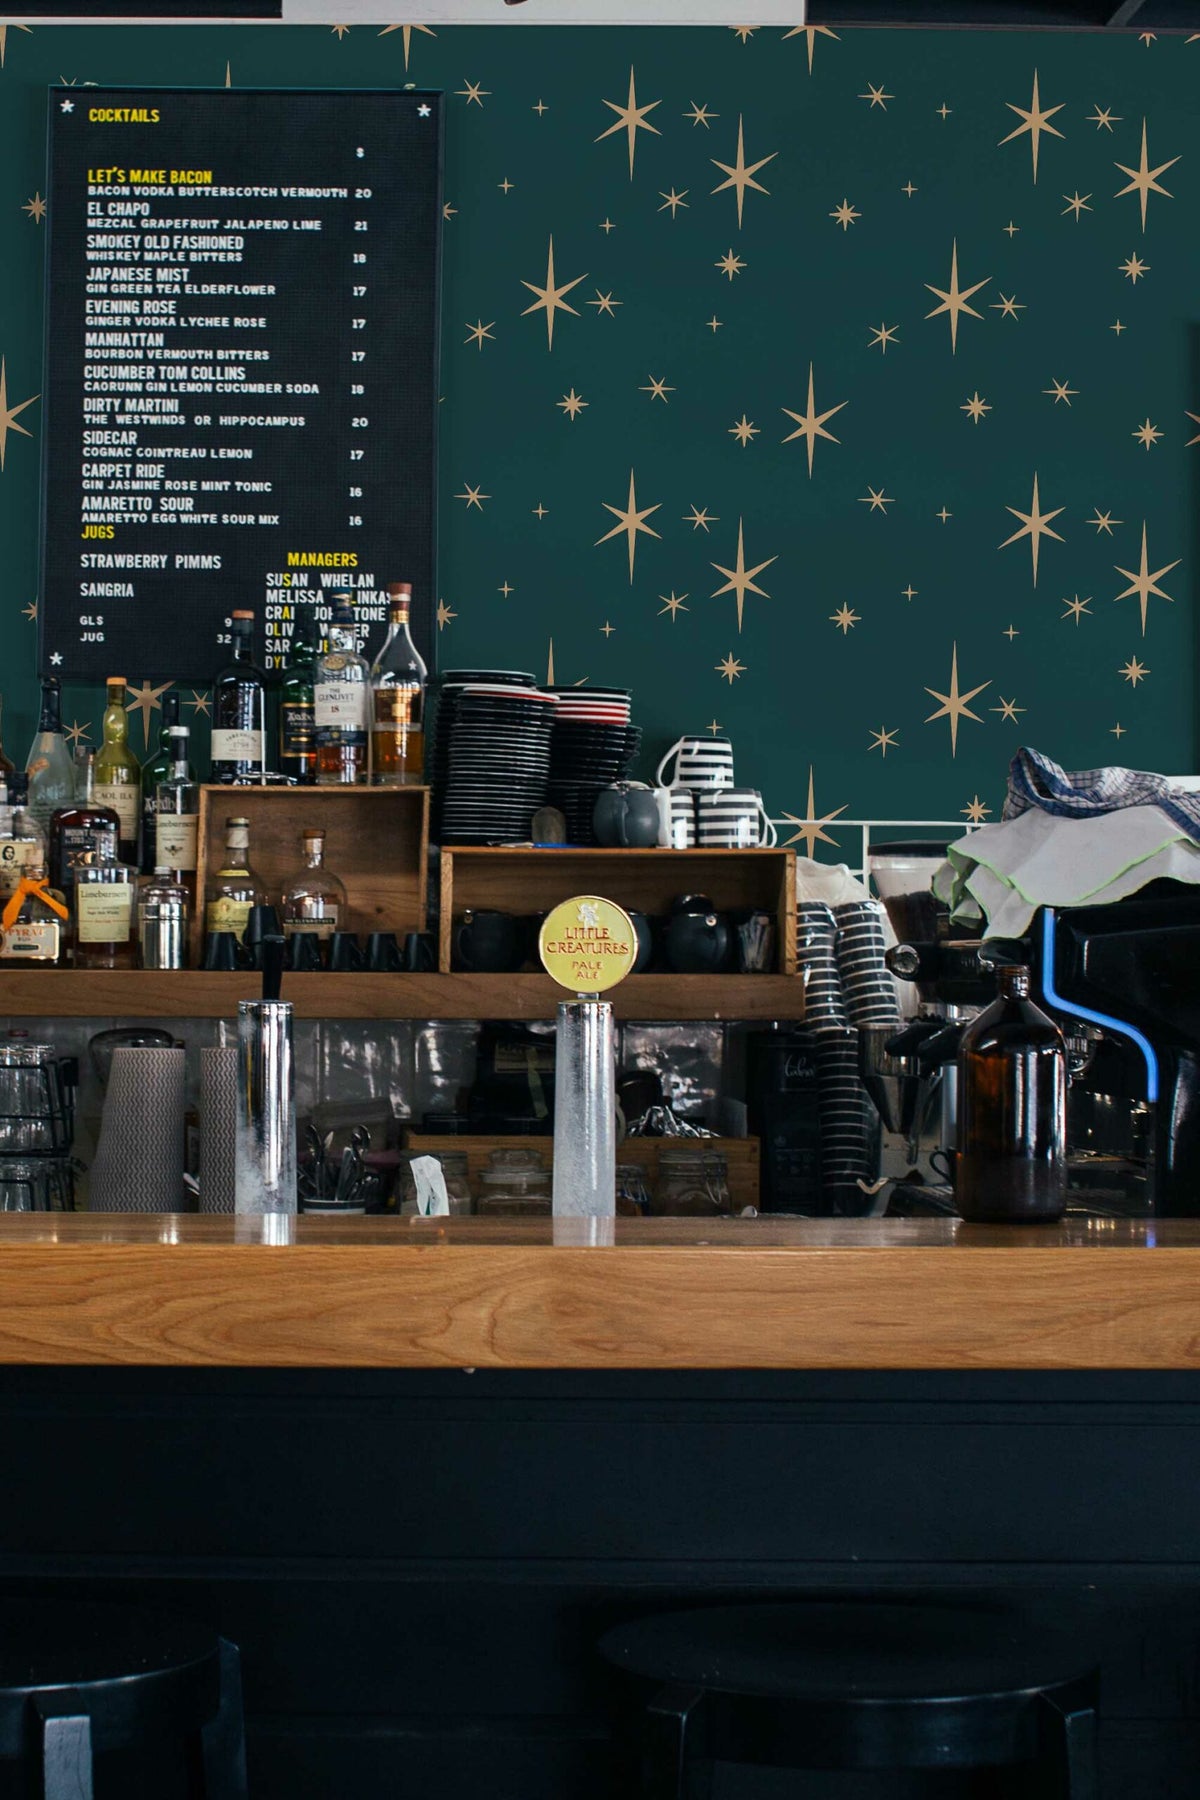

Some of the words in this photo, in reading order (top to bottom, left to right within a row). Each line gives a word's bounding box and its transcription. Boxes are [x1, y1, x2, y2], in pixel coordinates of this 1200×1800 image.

[89, 109, 159, 122] COCKTAILS
[88, 167, 125, 184] LET'S
[130, 170, 166, 183] MAKE
[171, 170, 212, 184] BACON
[88, 186, 130, 195] BACON
[133, 187, 174, 196] VODKA
[179, 187, 277, 197] BUTTERSCOTCH
[281, 187, 347, 197] VERMOUTH
[355, 189, 371, 198] 20
[88, 202, 104, 215] EL
[108, 202, 150, 216] CHAPO
[87, 218, 136, 228] MEZCAL
[141, 219, 219, 229] GRAPEFRUIT
[224, 220, 289, 229] JALAPENO
[293, 221, 321, 230] LIME
[354, 221, 367, 231] 21
[87, 235, 141, 249] SMOKEY
[144, 235, 169, 249] OLD
[173, 236, 244, 249] FASHIONED
[86, 251, 140, 261] WHISKEY
[144, 252, 185, 261] MAPLE
[190, 252, 242, 262] BITTERS
[354, 254, 366, 263] 18
[86, 267, 152, 281] JAPANESE
[157, 268, 189, 282] MIST
[86, 284, 107, 293] GIN
[111, 284, 152, 293] GREEN
[156, 284, 181, 294] TEA
[185, 284, 275, 295] ELDERFLOWER
[353, 286, 366, 296] 17
[86, 300, 139, 314] EVENING
[143, 300, 176, 314] ROSE
[86, 316, 131, 326] GINGER
[135, 317, 176, 326] VODKA
[180, 317, 229, 327] LYCHEE
[234, 317, 266, 327] ROSE
[353, 319, 366, 329] 17
[85, 333, 164, 346] MANHATTAN
[85, 349, 143, 359] BOURBON
[147, 349, 213, 359] VERMOUTH
[217, 350, 269, 360] BITTERS
[352, 352, 365, 361] 17
[84, 365, 155, 379] CUCUMBER
[159, 366, 187, 380] TOM
[191, 366, 245, 380] COLLINS
[84, 382, 142, 392] CAORUNN
[146, 382, 167, 392] GIN
[171, 382, 212, 392] LEMON
[216, 383, 282, 393] CUCUMBER
[286, 384, 319, 394] SODA
[352, 385, 364, 394] 18
[84, 398, 121, 412] DIRTY
[125, 398, 178, 412] MARTINI
[84, 414, 107, 424] THE
[116, 415, 185, 425] WESTWINDS
[194, 416, 211, 425] OR
[220, 416, 305, 426] HIPPOCAMPUS
[352, 418, 368, 427] 20
[83, 431, 137, 445] SIDECAR
[83, 447, 132, 457] COGNAC
[136, 448, 206, 458] COINTREAU
[211, 449, 252, 458] LEMON
[351, 450, 364, 460] 17
[82, 464, 132, 478] CARPET
[136, 464, 165, 478] RIDE
[82, 480, 103, 490] GIN
[108, 480, 160, 490] JASMINE
[165, 481, 197, 490] ROSE
[201, 481, 231, 491] MINT
[235, 482, 272, 492] TONIC
[350, 487, 362, 497] 16
[82, 497, 152, 511] AMARETTO
[160, 497, 193, 511] SOUR
[82, 513, 147, 523] AMARETTO
[152, 513, 177, 523] EGG
[180, 514, 217, 523] WHITE
[222, 514, 255, 524] SOUR
[259, 515, 279, 524] MIX
[349, 516, 362, 526] 16
[82, 526, 114, 539] JUGS
[81, 554, 168, 568] STRAWBERRY
[176, 555, 221, 569] PIMMS
[288, 552, 357, 566] MANAGERS
[266, 573, 308, 587] SUSAN
[320, 574, 374, 588] WHELAN
[80, 583, 134, 597] SANGRIA
[266, 589, 324, 603] MELISSA
[266, 606, 294, 619] CRAI
[80, 616, 103, 625] GLS
[225, 618, 232, 627] 9
[266, 623, 294, 636] OLIV
[80, 632, 104, 641] JUG
[217, 634, 231, 643] 32
[266, 639, 290, 652] SAR
[266, 656, 287, 669] DYL
[566, 927, 611, 940] LITTLE
[546, 942, 630, 955] CREATURES
[572, 961, 603, 970] PALE
[576, 971, 599, 980] ALE
